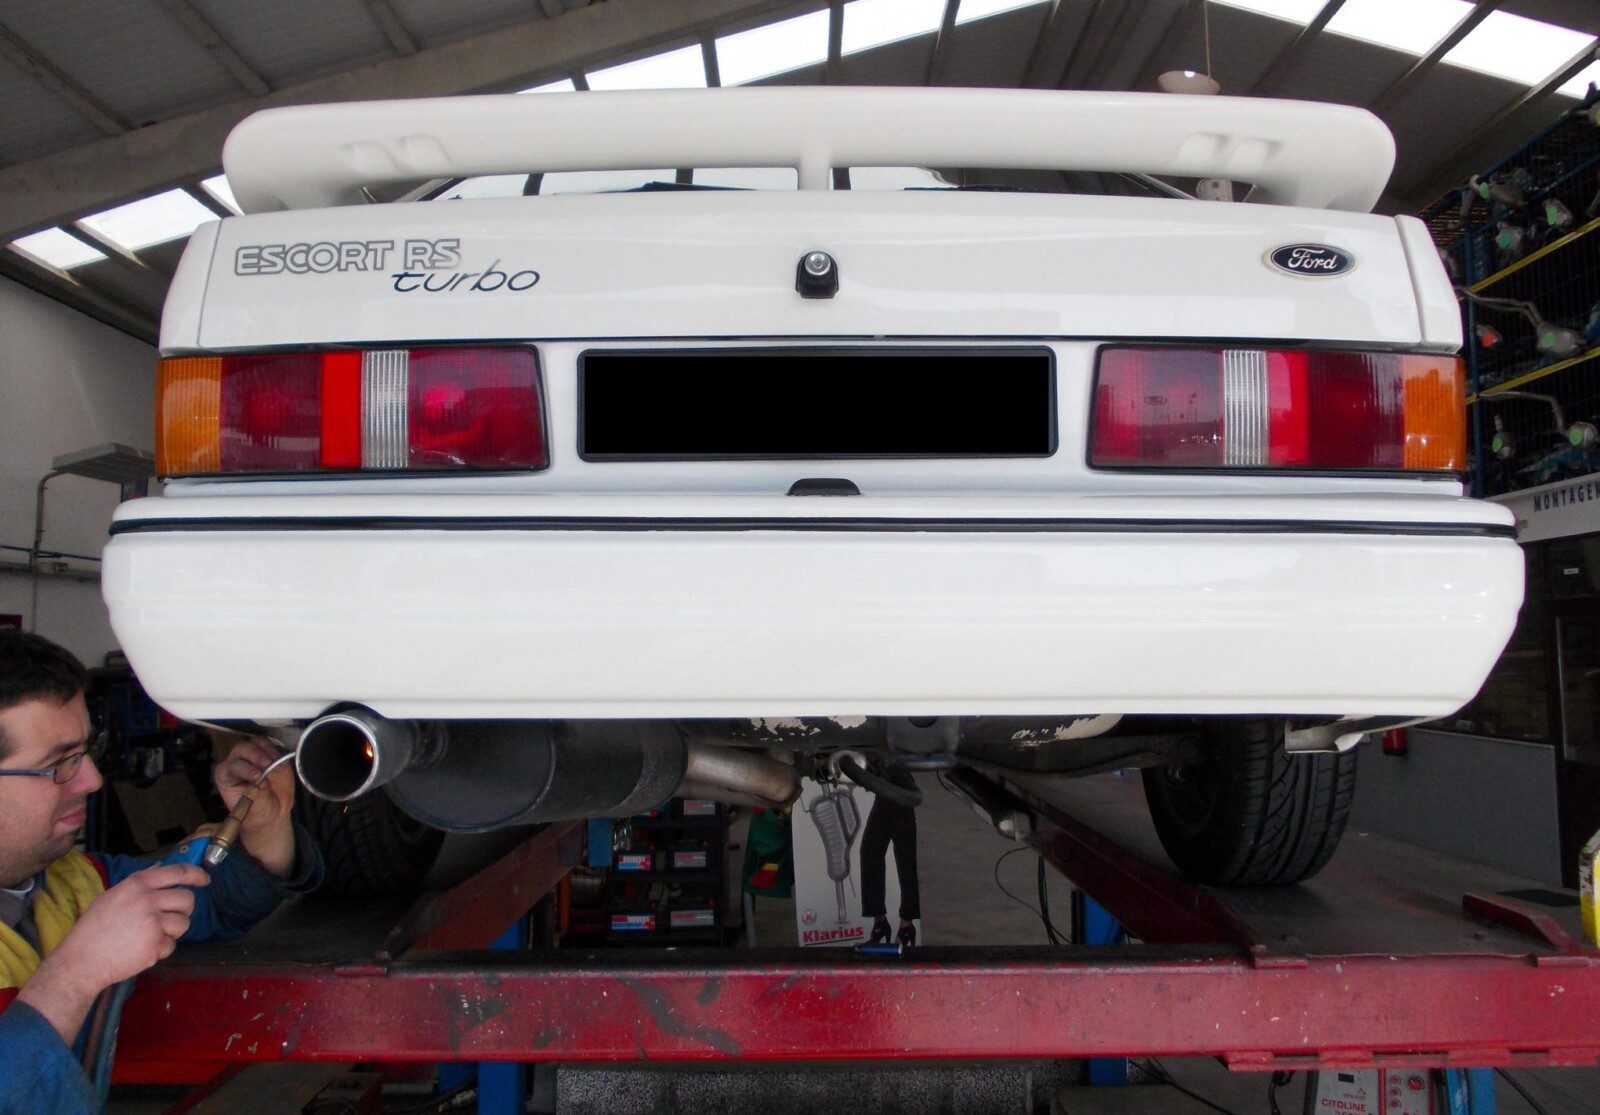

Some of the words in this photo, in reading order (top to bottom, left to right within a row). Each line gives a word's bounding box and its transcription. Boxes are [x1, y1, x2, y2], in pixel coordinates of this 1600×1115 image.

[234, 240, 394, 276] ESCORT
[404, 238, 462, 271] RS
[1288, 248, 1338, 269] Ford
[391, 259, 540, 293] turbo
[803, 926, 864, 944] Klarius
